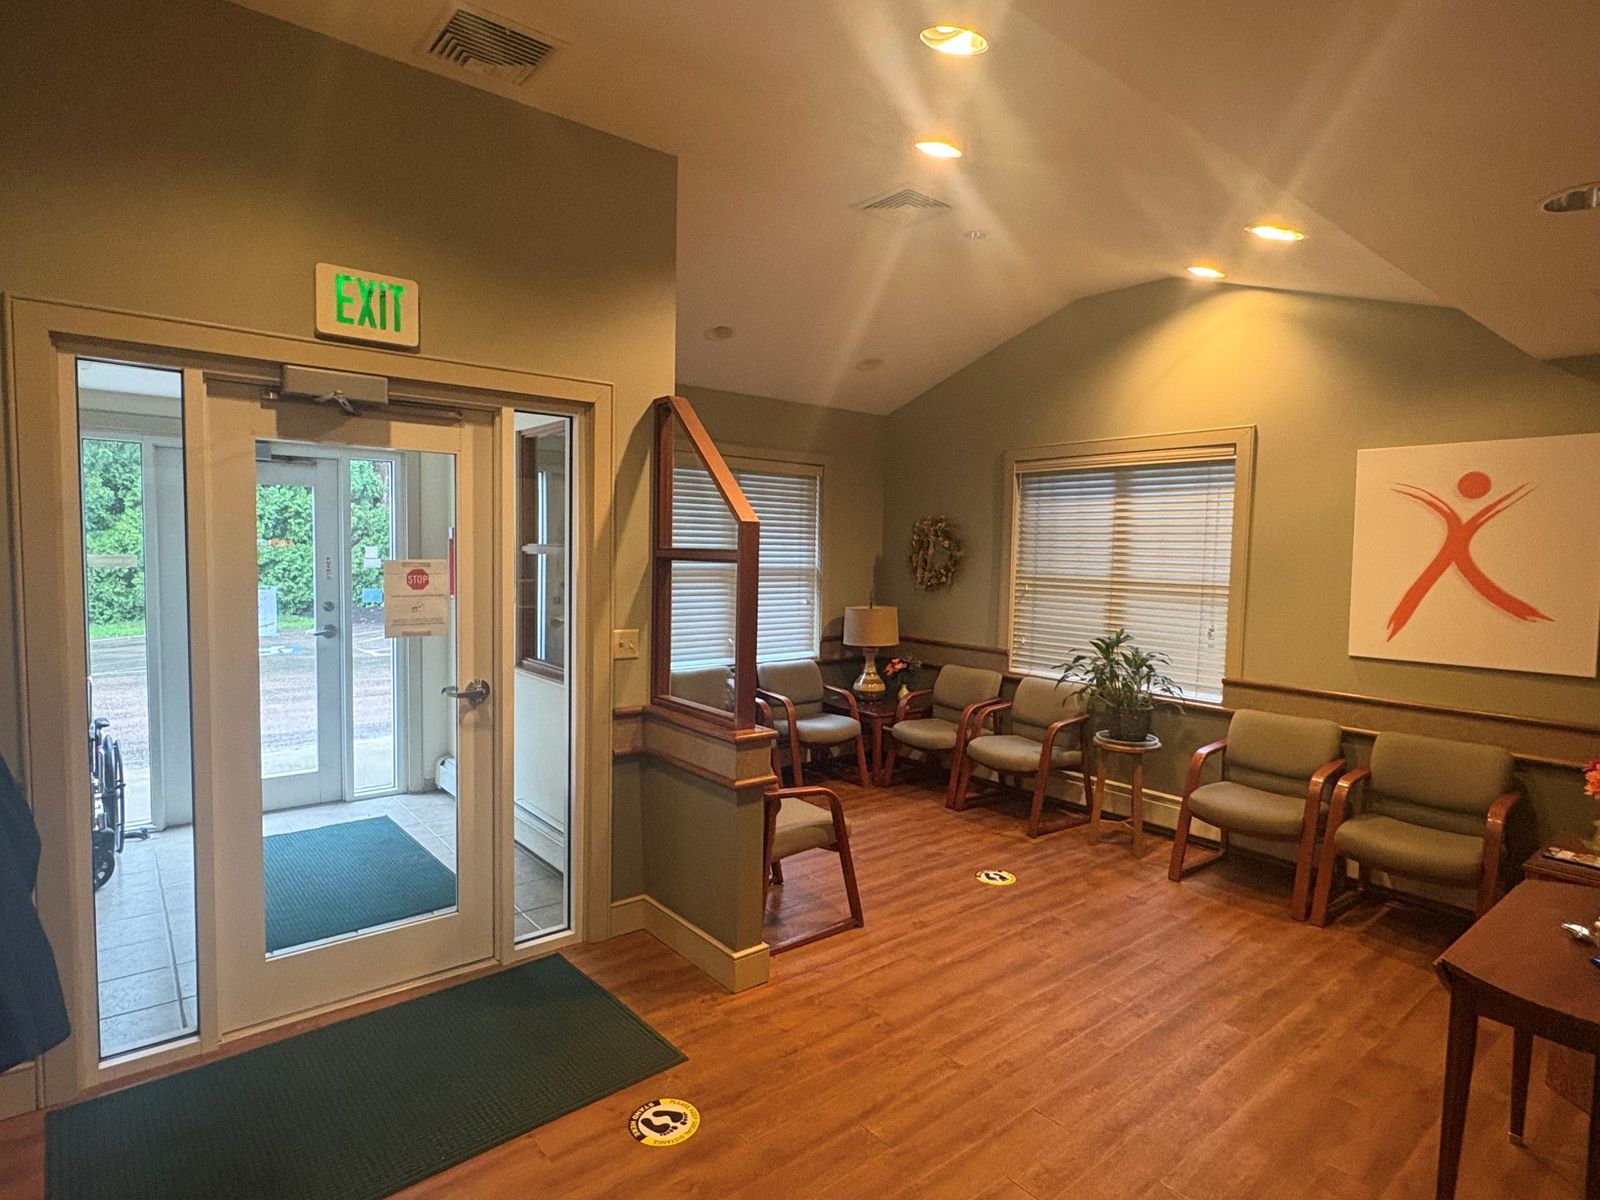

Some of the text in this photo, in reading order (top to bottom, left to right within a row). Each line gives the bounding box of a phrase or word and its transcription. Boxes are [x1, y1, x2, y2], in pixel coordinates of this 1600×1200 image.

[335, 273, 406, 333] EXIT
[407, 575, 428, 585] STOP
[630, 1102, 654, 1138] STAND HERE
